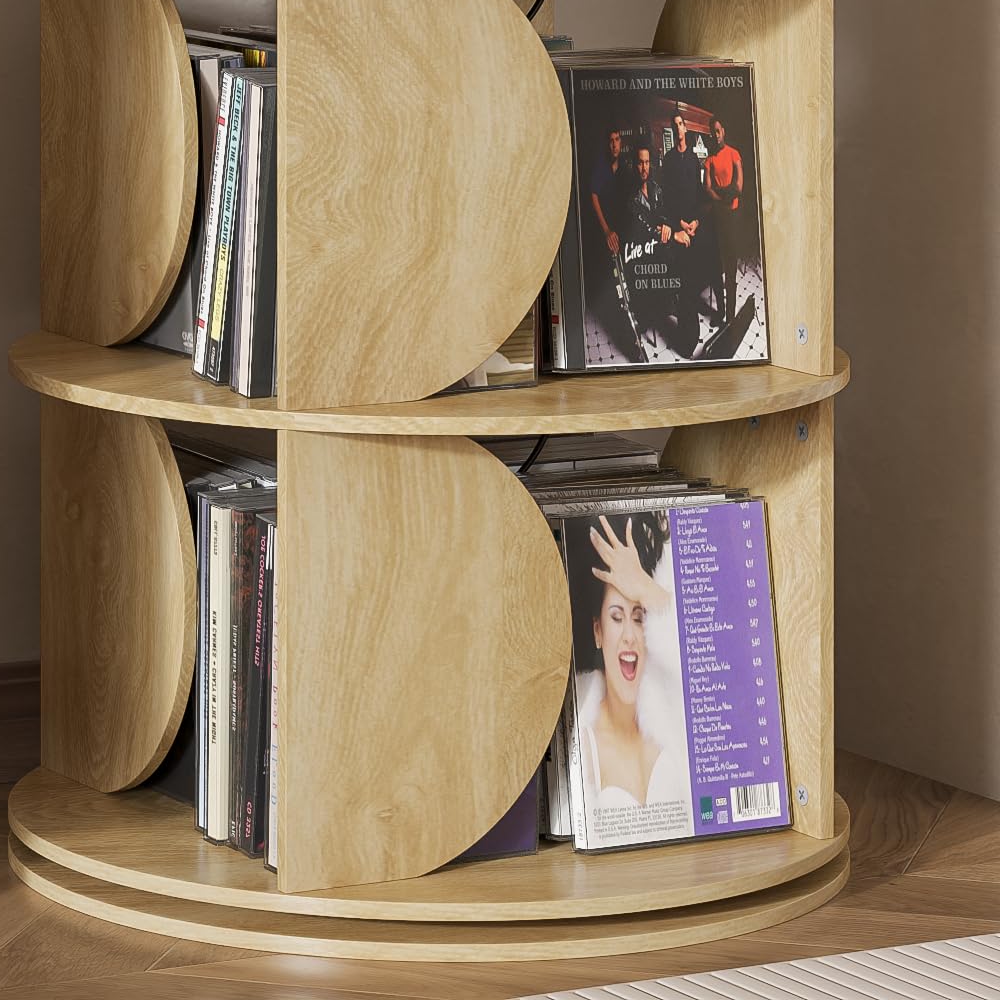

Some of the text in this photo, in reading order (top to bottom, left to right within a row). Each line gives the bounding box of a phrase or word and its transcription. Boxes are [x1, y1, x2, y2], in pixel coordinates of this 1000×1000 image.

[580, 76, 744, 90] HOWARD AND THE WHITE BOYS
[225, 186, 233, 213] TOWN
[220, 216, 230, 261] PLAYBOYS
[624, 239, 659, 263] Live at
[634, 264, 667, 275] CHORD
[635, 278, 681, 289] ON BLUES
